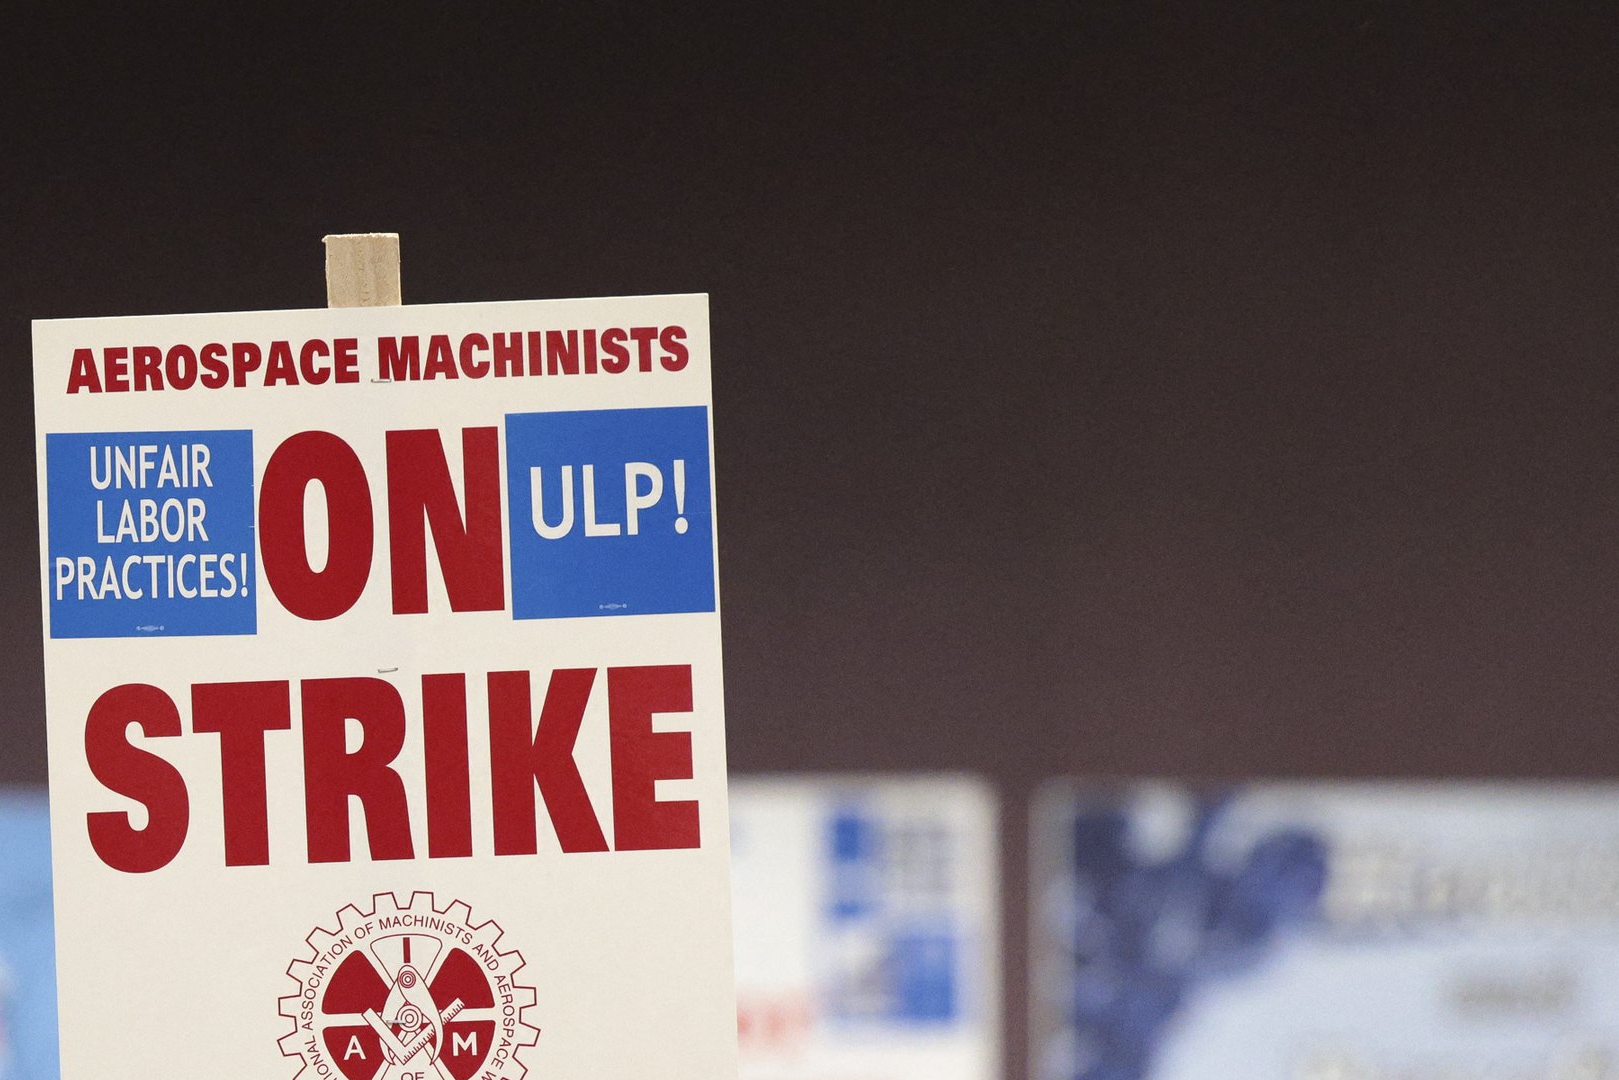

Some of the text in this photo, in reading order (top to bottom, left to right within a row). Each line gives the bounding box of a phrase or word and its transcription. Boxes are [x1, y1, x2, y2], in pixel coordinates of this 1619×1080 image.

[66, 326, 690, 395] AEROSPACE MACHINISTS
[90, 443, 214, 490] UNFAIR
[530, 459, 689, 540] ULP!
[96, 498, 209, 544] LABOR
[258, 426, 506, 621] ON
[55, 552, 248, 601] PRACTICES!
[84, 663, 701, 874] STRIKE
[301, 935, 353, 1031] ASSOCIATION
[354, 922, 374, 940] OF
[379, 914, 474, 945] MACHINISTS
[472, 943, 499, 972] AND
[494, 972, 516, 1070] AEROSPACE
[343, 1031, 478, 1061] A M
